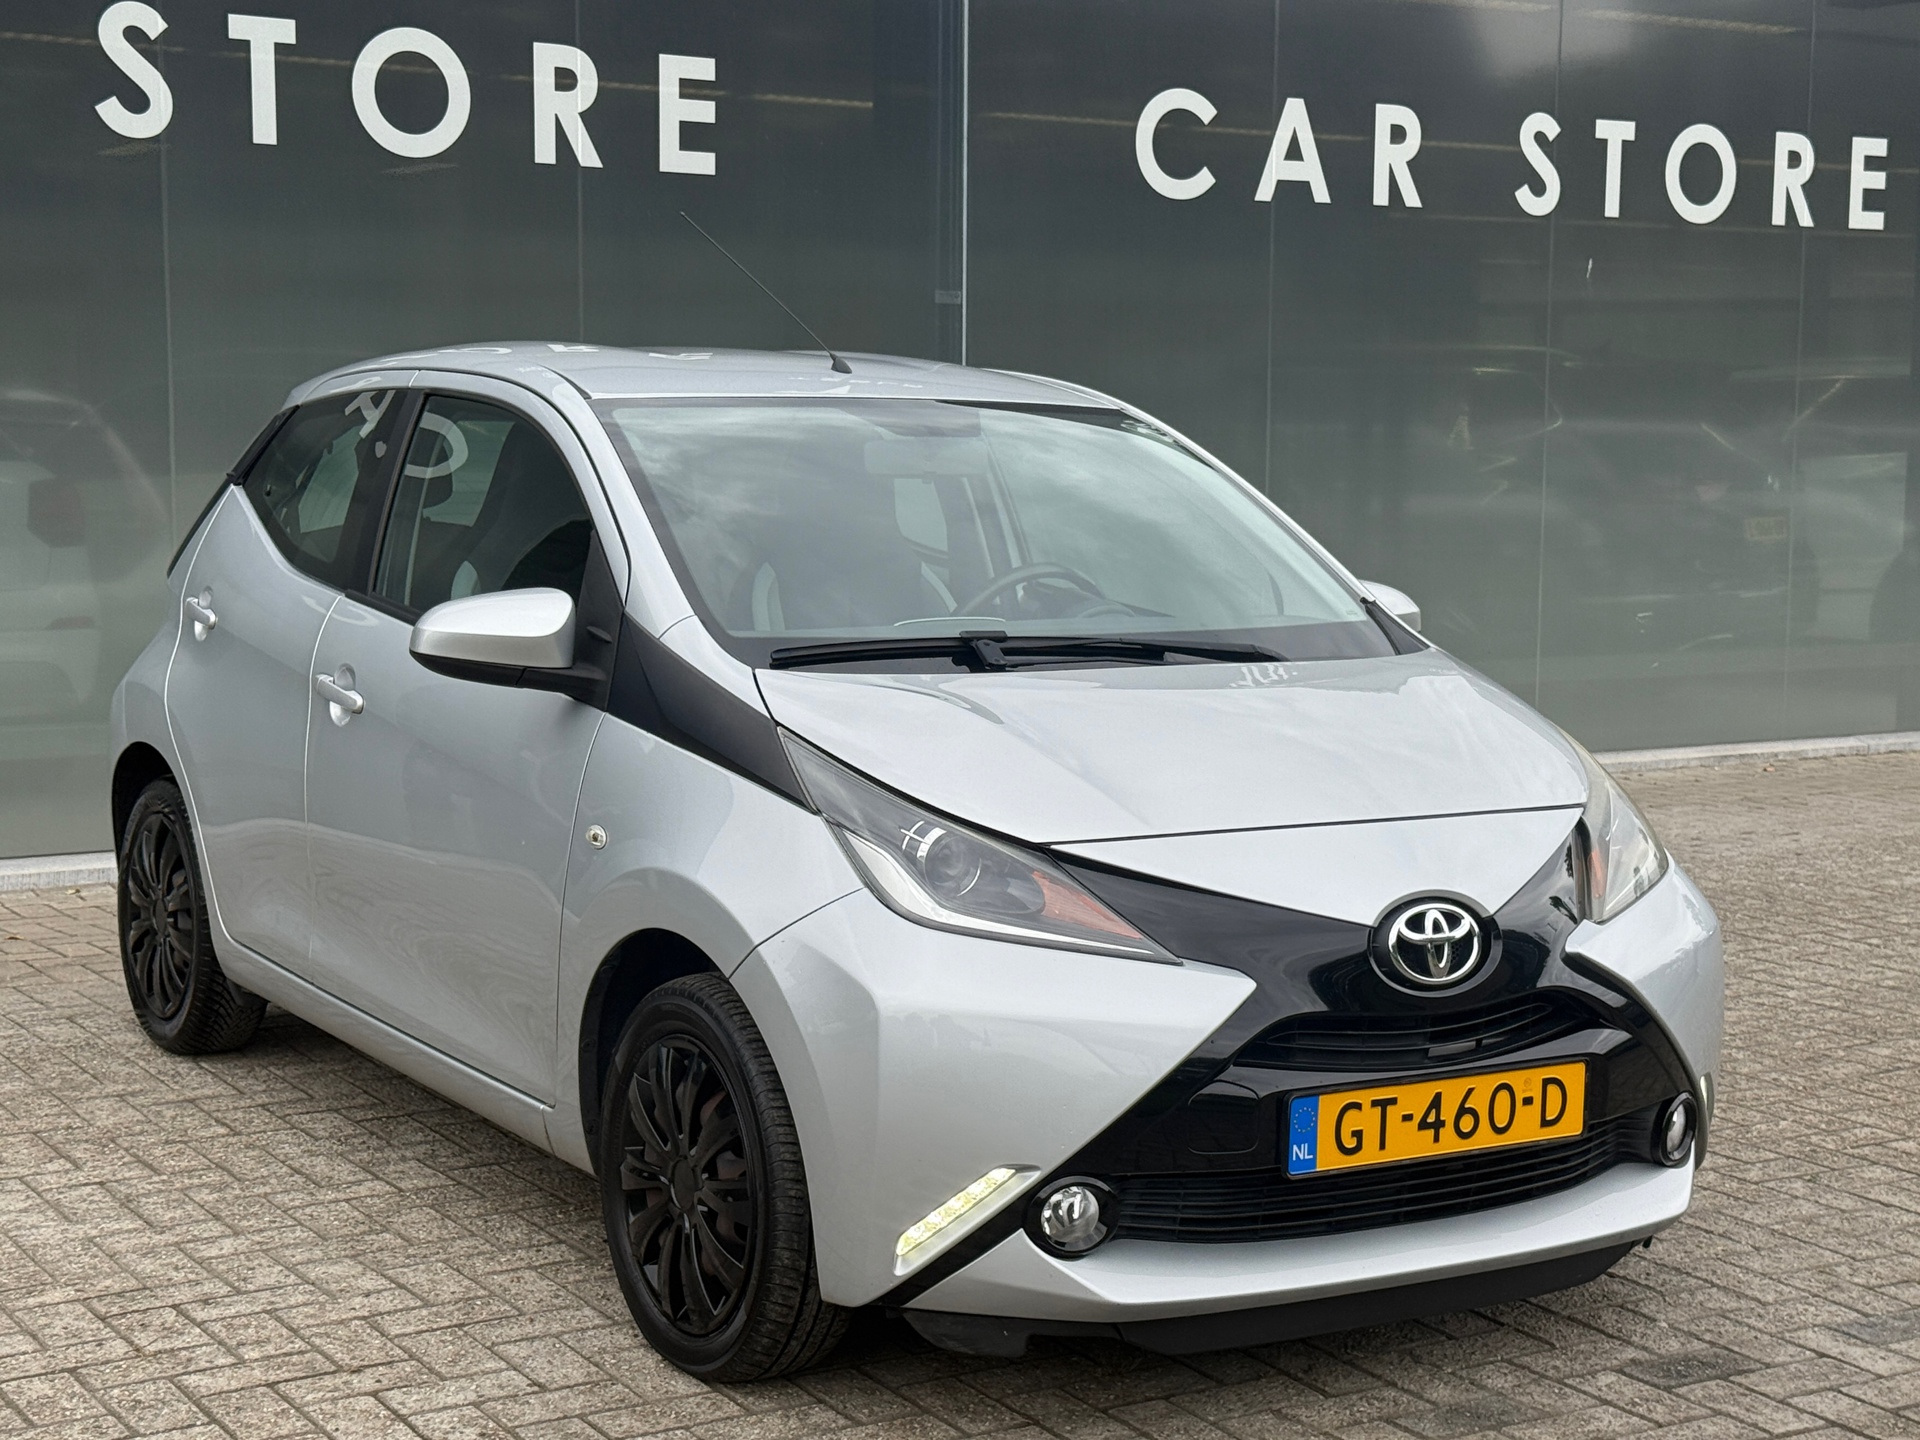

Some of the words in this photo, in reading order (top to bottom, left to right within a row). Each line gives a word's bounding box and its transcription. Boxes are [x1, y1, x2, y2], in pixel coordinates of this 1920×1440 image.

[94, 0, 717, 176] STORE
[1135, 87, 1423, 208] CAR
[1514, 111, 1889, 231] STORE
[1292, 1144, 1313, 1162] NL
[1334, 1076, 1568, 1156] GT-460-D
